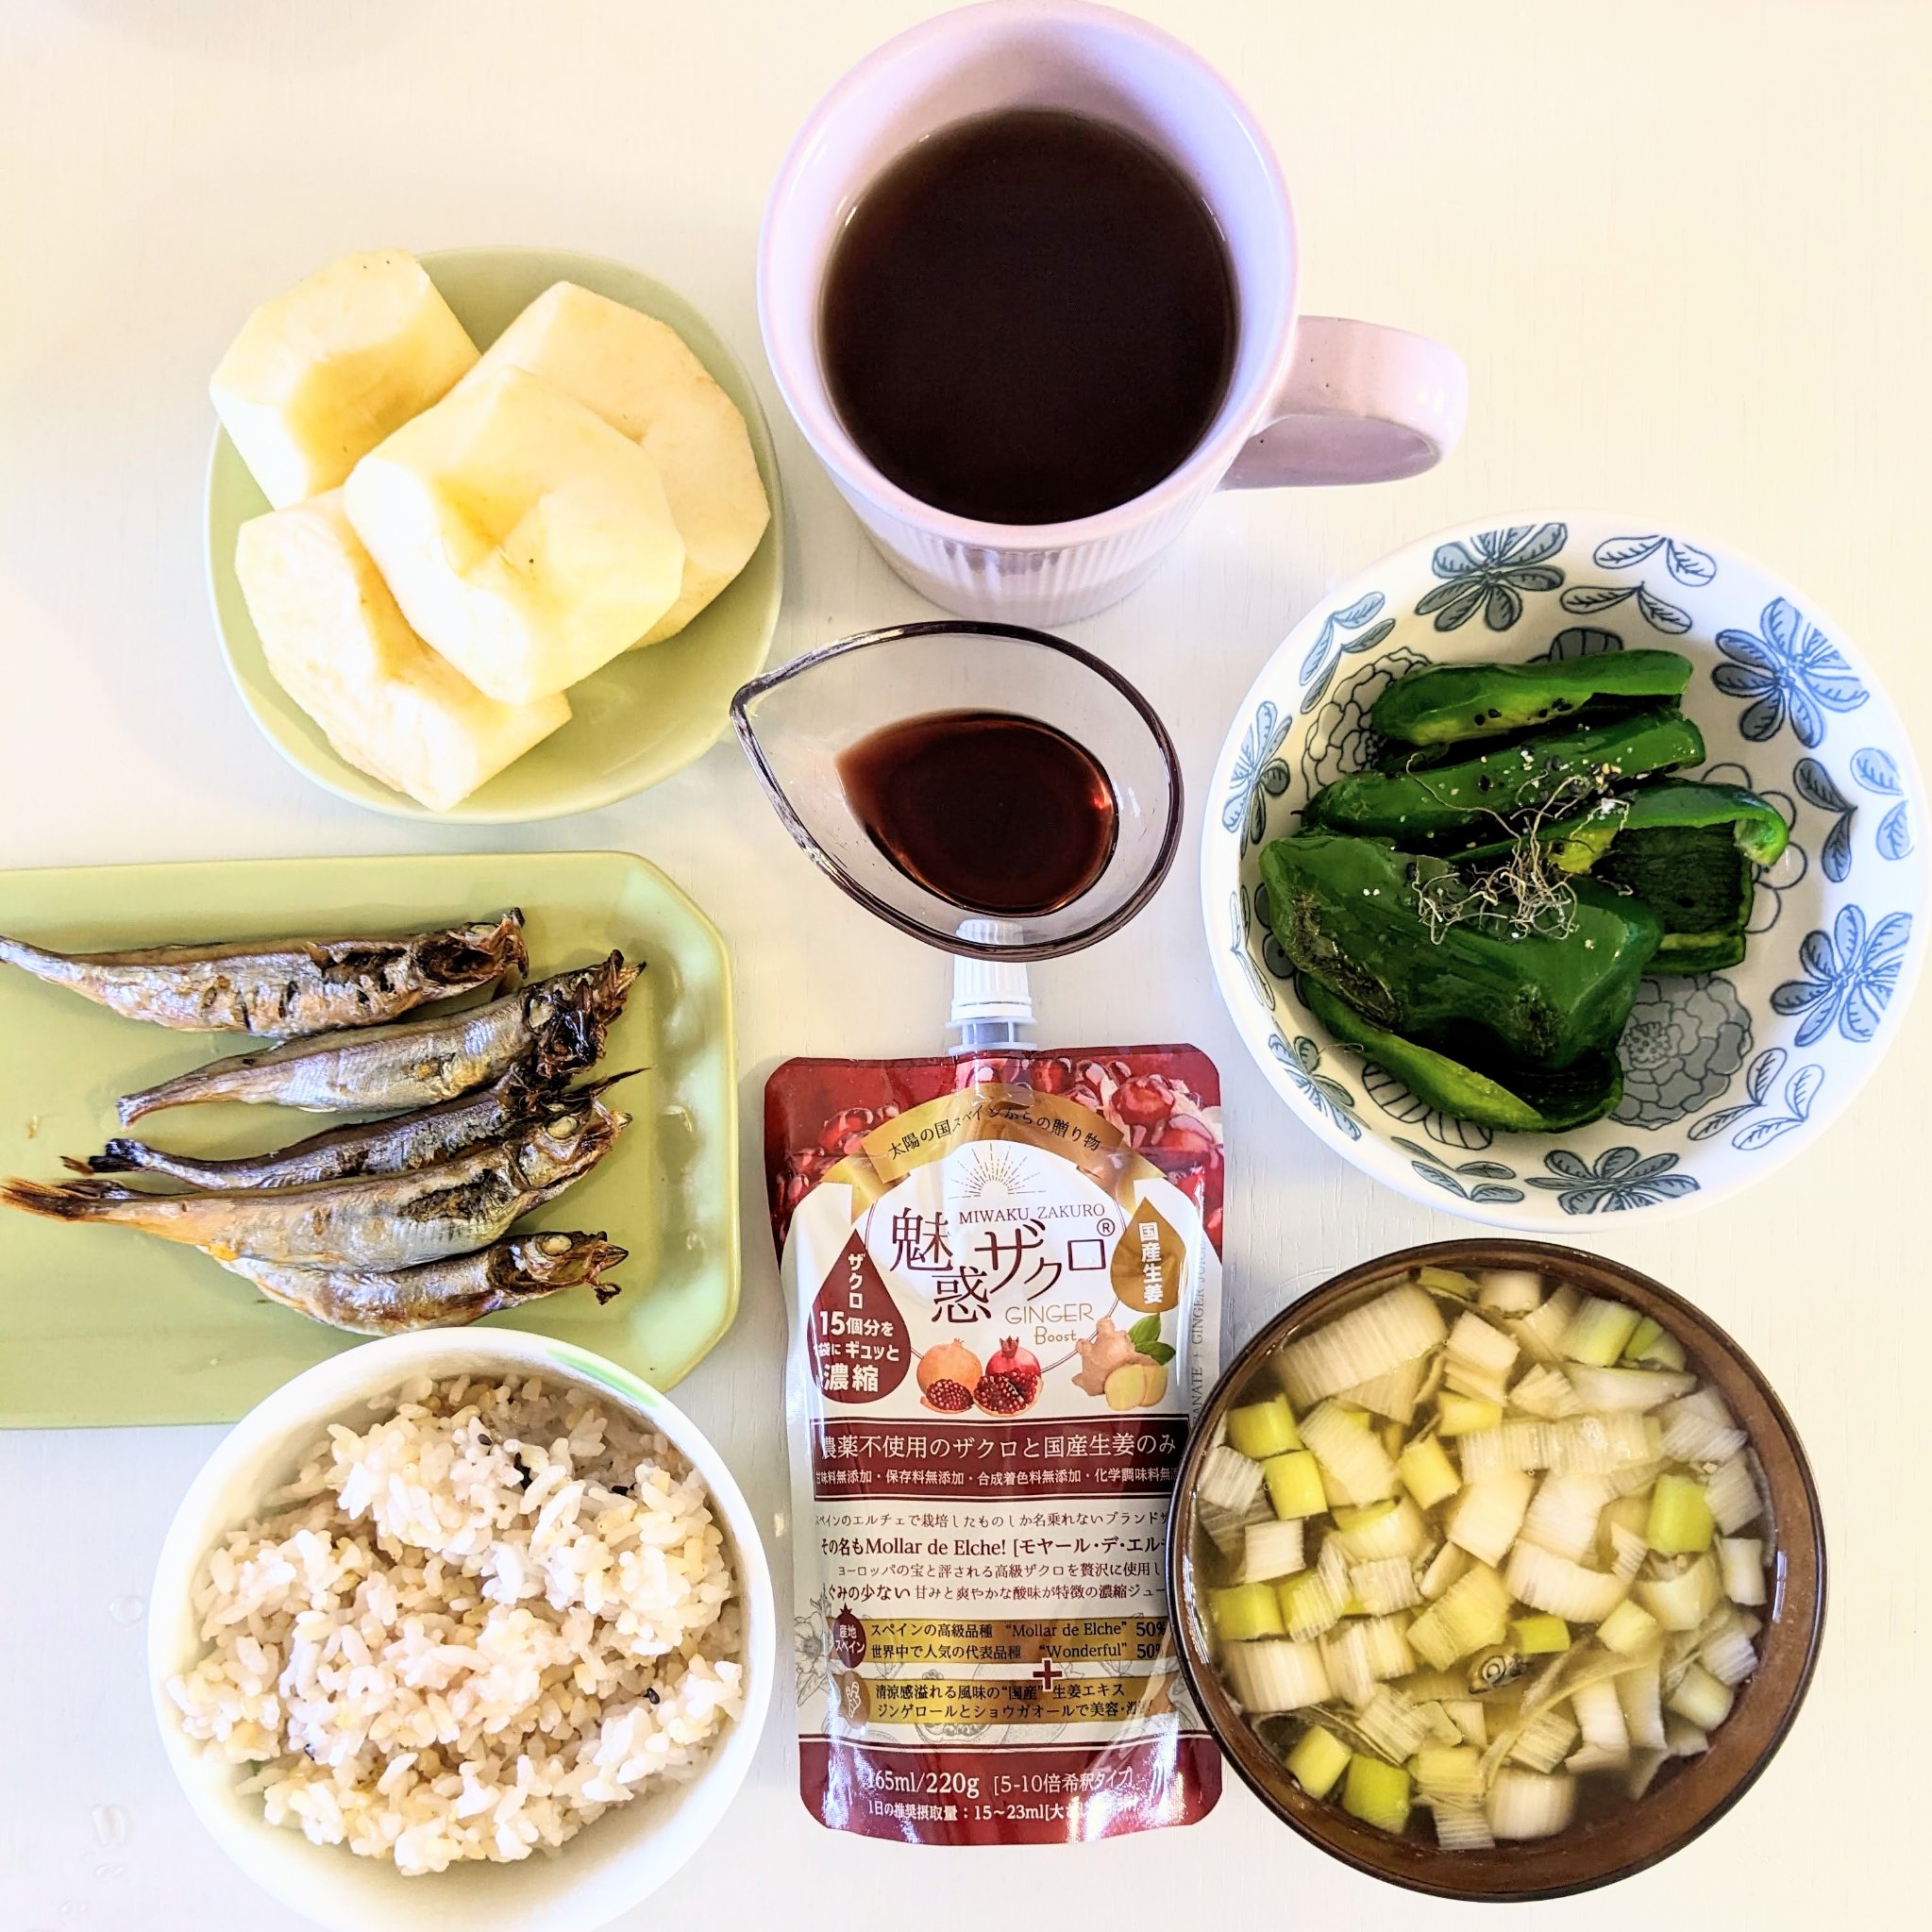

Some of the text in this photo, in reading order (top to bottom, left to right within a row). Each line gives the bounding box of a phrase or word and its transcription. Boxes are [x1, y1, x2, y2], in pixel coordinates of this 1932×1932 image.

[887, 1105, 1101, 1160] 太陽の国スペインからの贈り物
[959, 1203, 1105, 1224] MIWAKU ZAKURO
[1138, 1222, 1164, 1304] 国産生姜
[848, 1253, 865, 1309] ザクロ
[819, 1310, 894, 1337] 15個分を
[1005, 1303, 1094, 1324] GINGER
[1034, 1326, 1077, 1345] Boost
[824, 1363, 879, 1392] 濃縮
[822, 1433, 1176, 1460] 農薬不使用のザクロと国産生姜のみ
[927, 1538, 949, 1555] de
[953, 1539, 1006, 1556] Elche!
[839, 1624, 857, 1639] 産地
[870, 1622, 993, 1638] スペインの高級品種
[1062, 1622, 1080, 1637] de
[834, 1639, 865, 1654] スペイン
[871, 1644, 1021, 1660] 世界中で人気の代表品種
